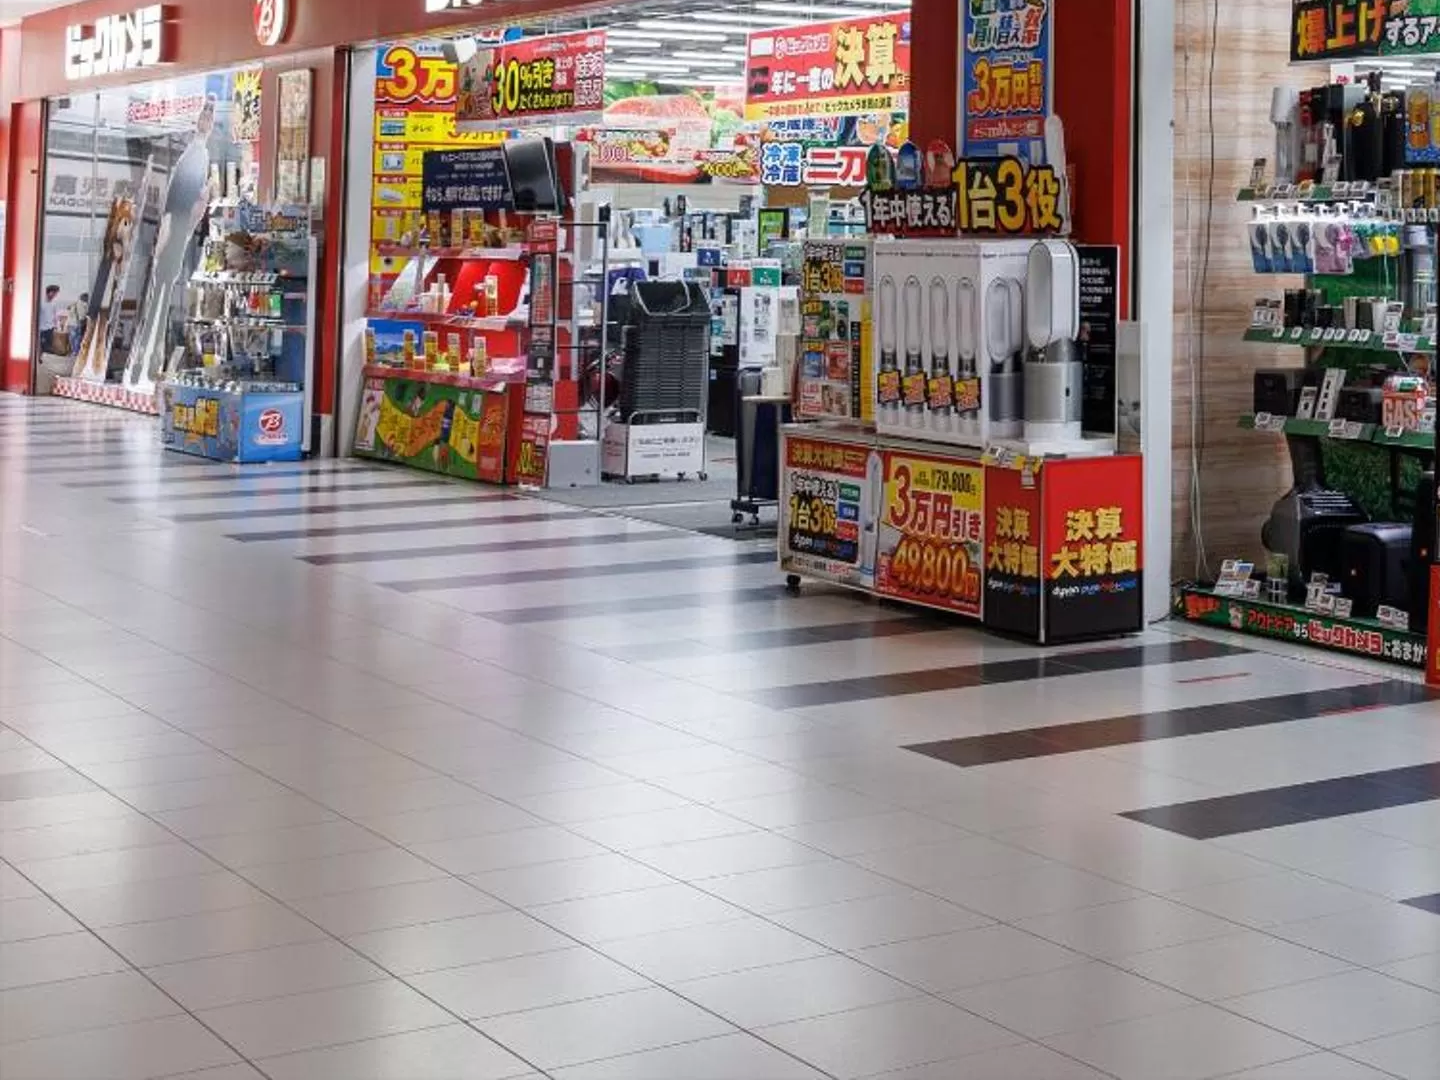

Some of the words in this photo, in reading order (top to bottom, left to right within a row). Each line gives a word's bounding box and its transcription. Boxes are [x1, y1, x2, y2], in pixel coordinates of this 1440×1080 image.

[861, 189, 957, 229] 1年中使える!
[953, 158, 1061, 231] 1台3役
[1066, 506, 1122, 540] 決算
[1051, 541, 1137, 579] 大特価
